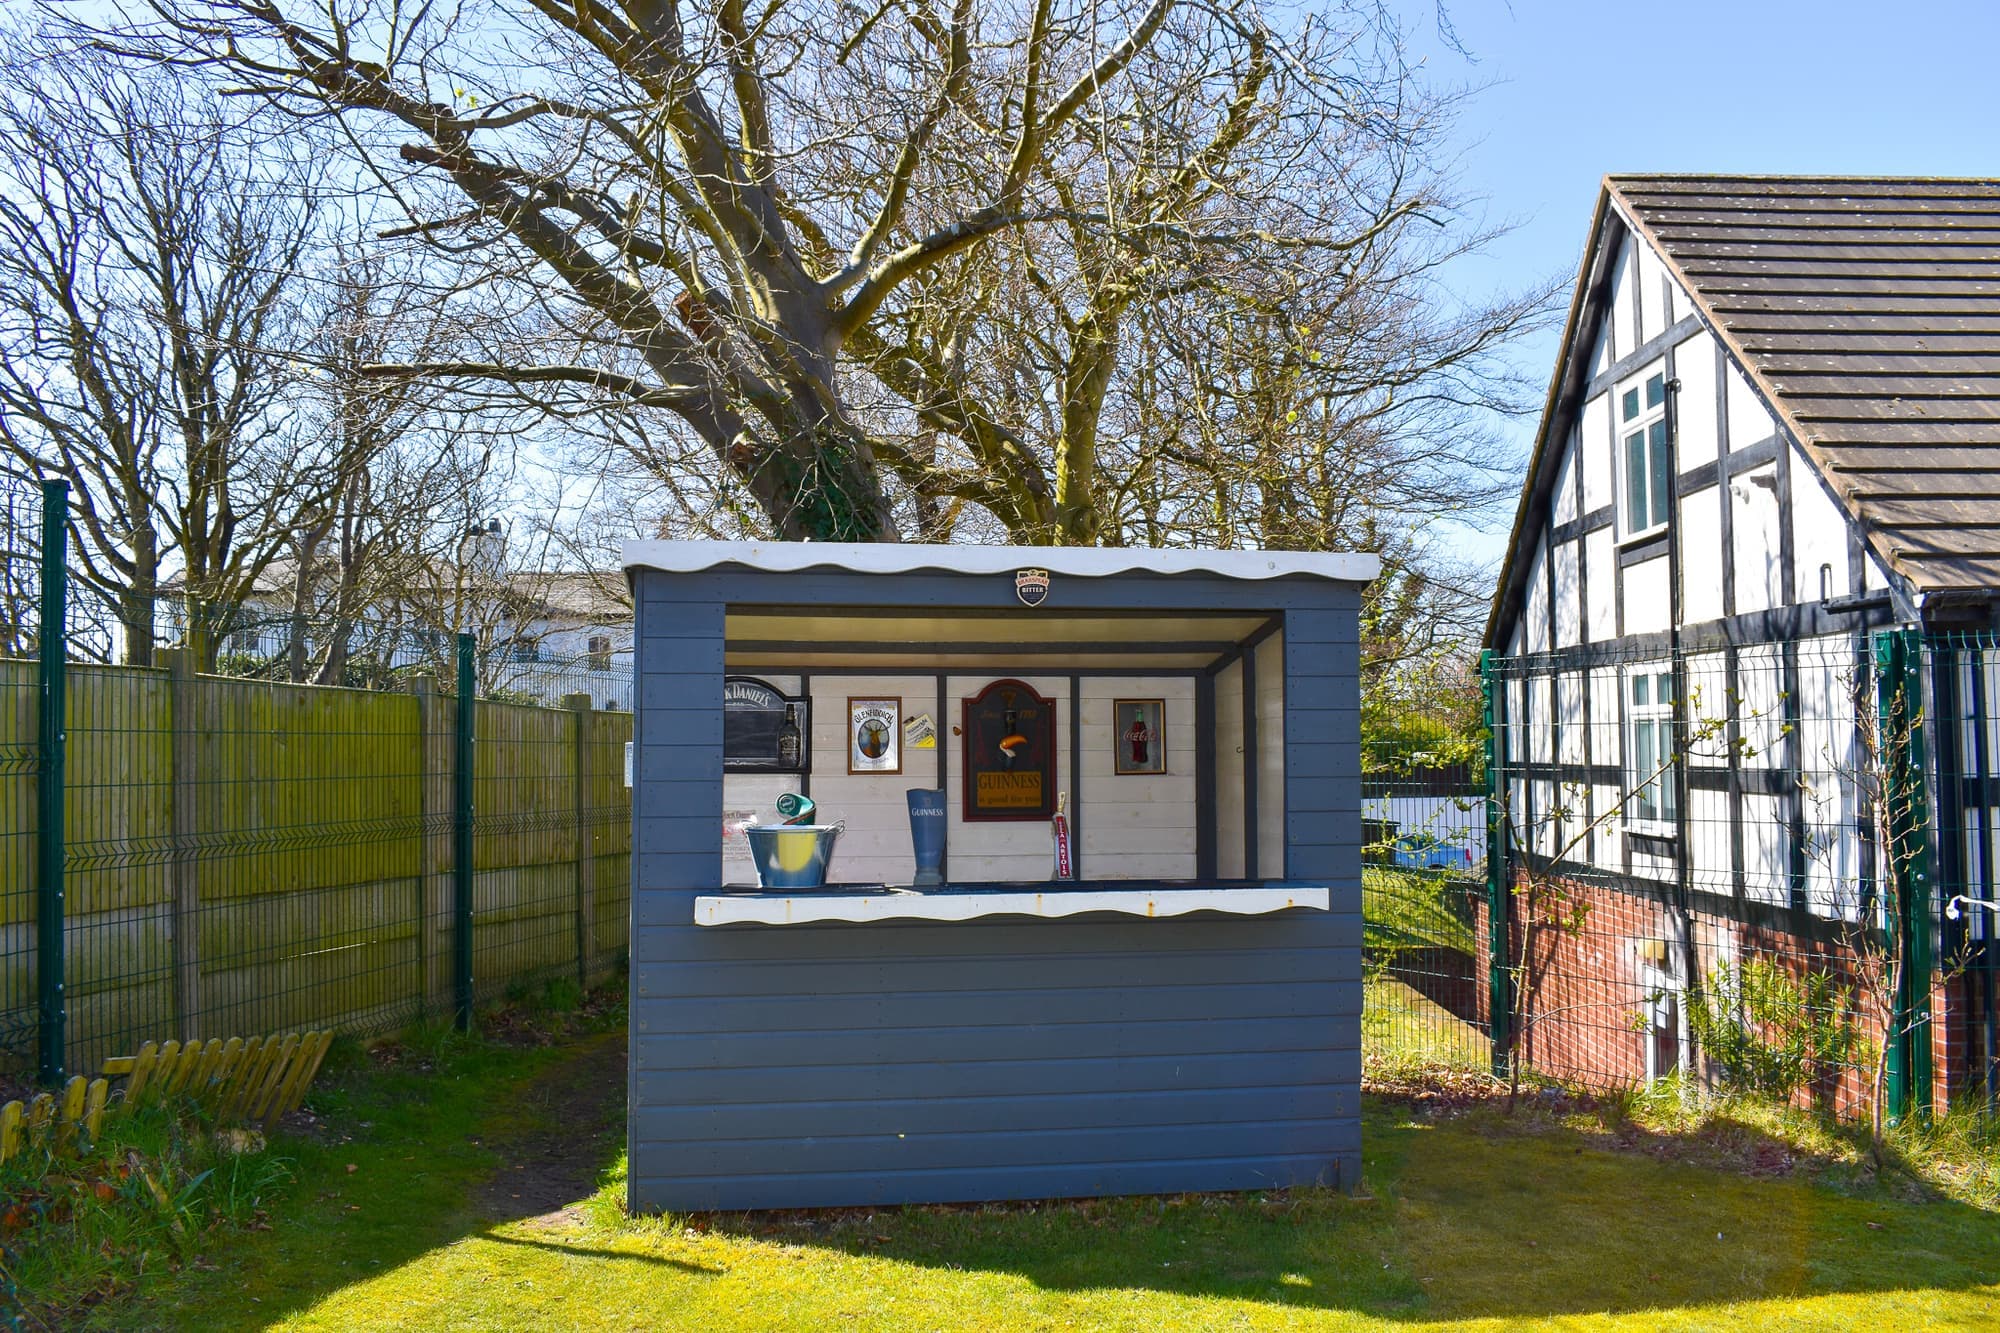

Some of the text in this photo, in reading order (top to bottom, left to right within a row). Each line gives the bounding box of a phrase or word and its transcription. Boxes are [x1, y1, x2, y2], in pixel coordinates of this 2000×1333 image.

[979, 774, 1040, 789] GUINNESS
[911, 807, 944, 817] GUINNESS
[1060, 843, 1068, 875] ARTOIS
